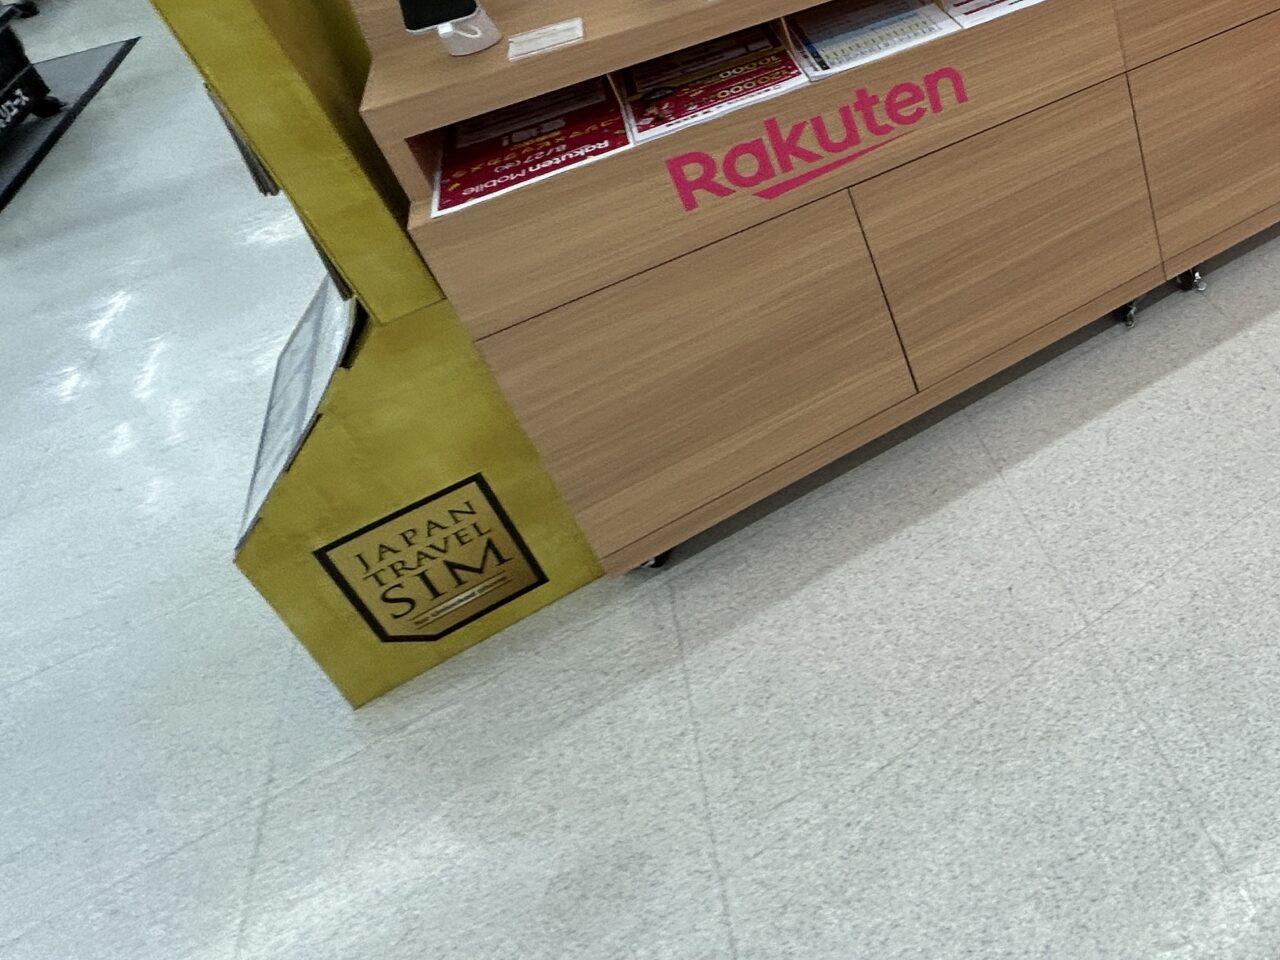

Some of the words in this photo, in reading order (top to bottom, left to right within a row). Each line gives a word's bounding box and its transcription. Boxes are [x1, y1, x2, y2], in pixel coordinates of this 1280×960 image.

[527, 140, 610, 173] Rakuten
[663, 65, 969, 212] Rakuten
[461, 169, 526, 196] Mobile
[354, 500, 478, 575] JAPAN
[362, 521, 493, 590] TRAVEL
[379, 536, 512, 620] SIM
